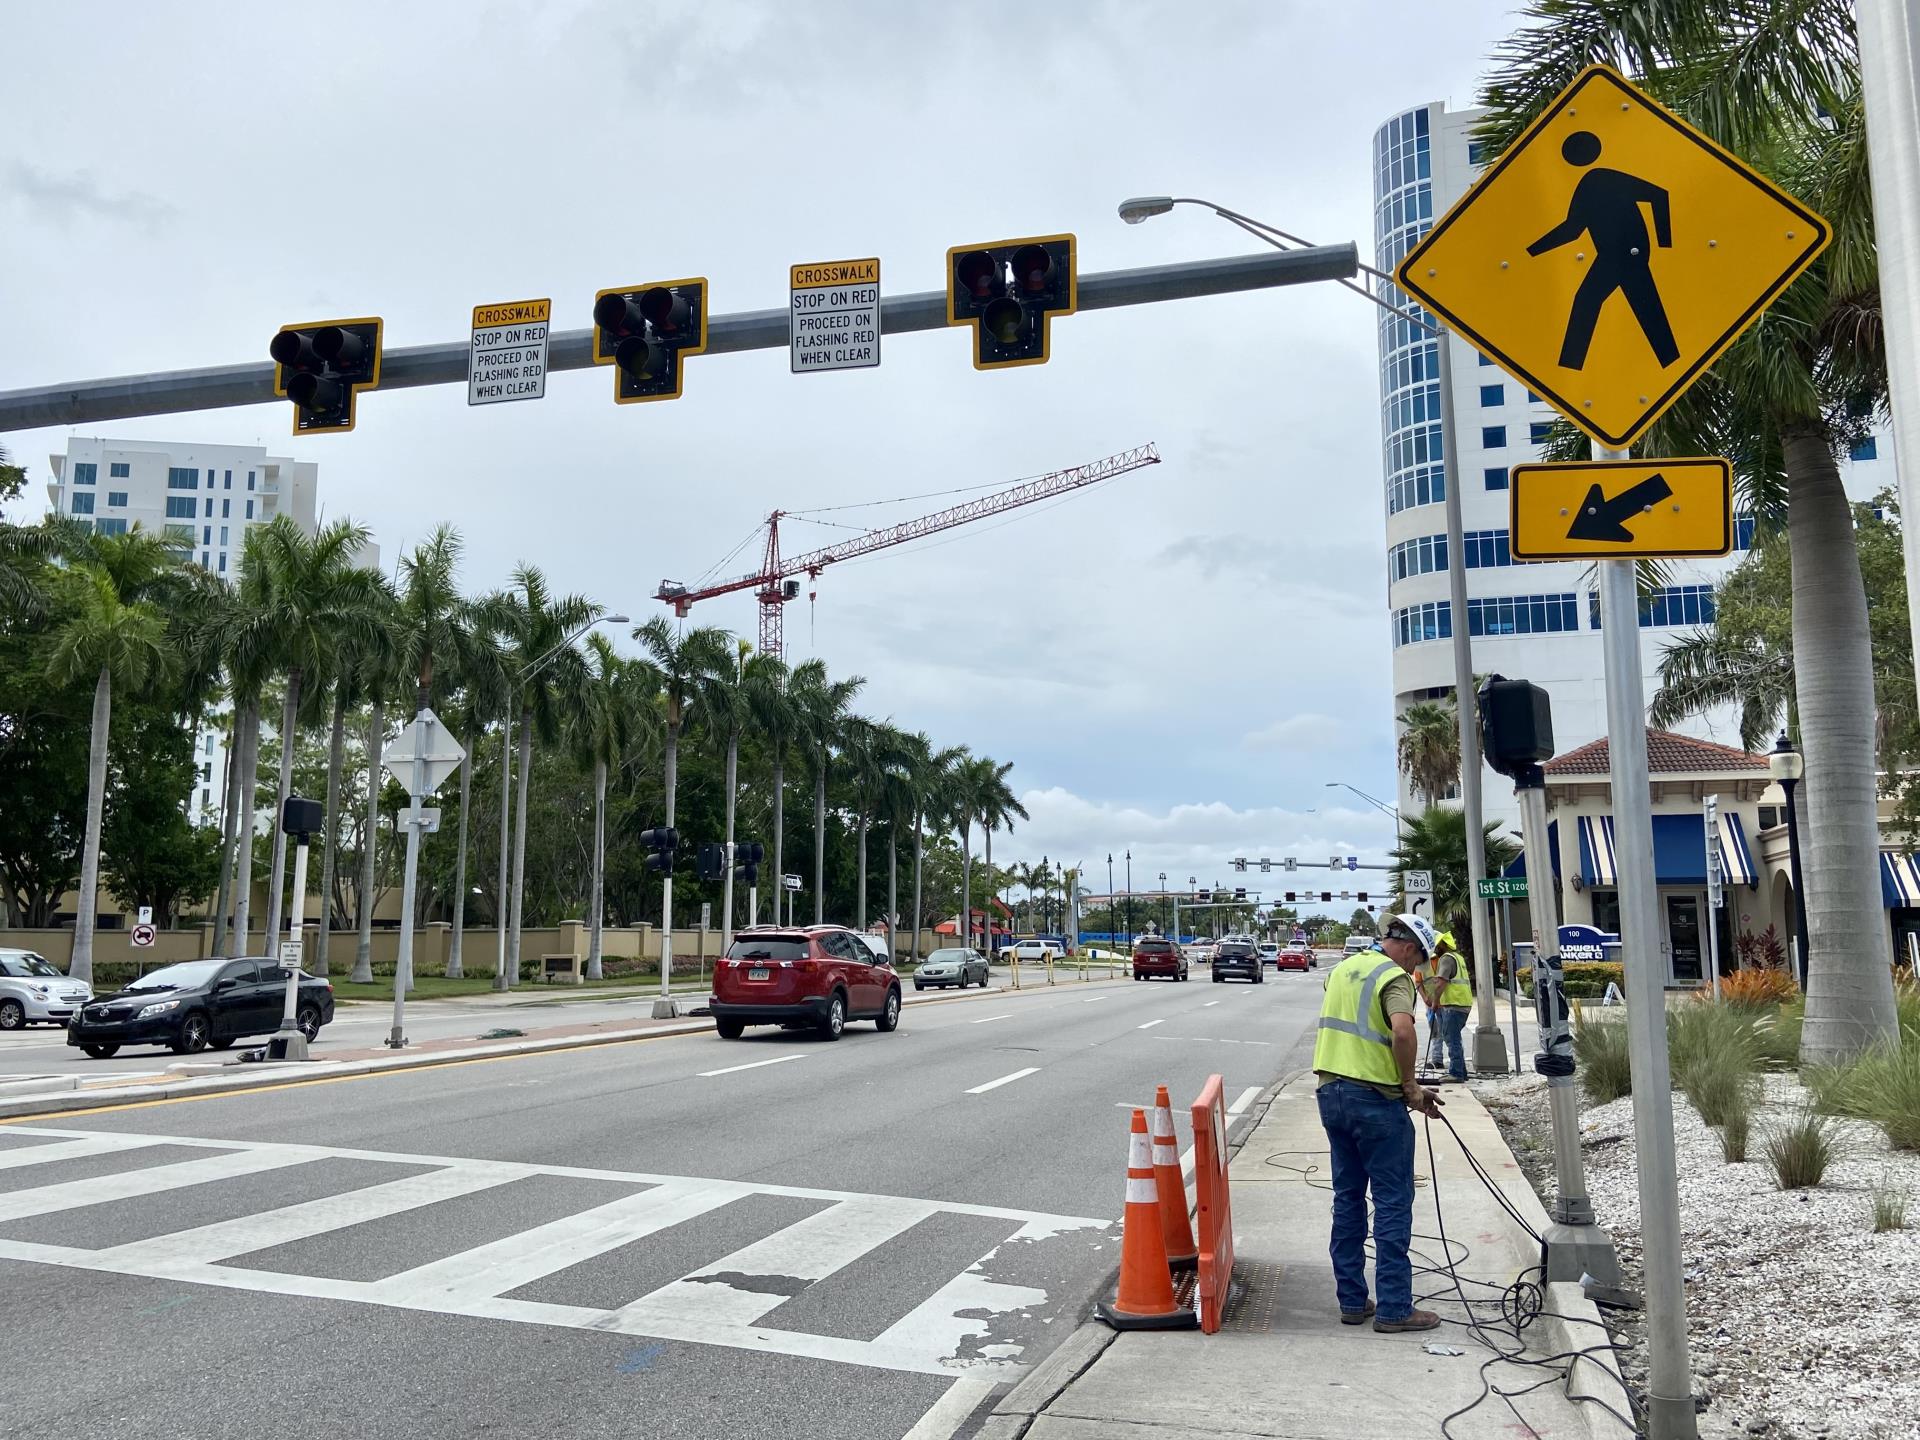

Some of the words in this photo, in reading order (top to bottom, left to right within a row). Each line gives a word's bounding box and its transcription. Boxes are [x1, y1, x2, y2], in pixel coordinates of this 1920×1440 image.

[796, 265, 873, 283] CROSSWALK
[794, 293, 826, 309] STOP
[830, 291, 848, 306] ON
[852, 289, 877, 304] RED
[477, 305, 545, 323] CROSSWALK
[800, 316, 850, 331] PROCEED
[855, 313, 871, 326] ON
[474, 332, 501, 346] STOP
[505, 330, 521, 344] ON
[524, 327, 546, 341] RED
[796, 333, 848, 348] FLASHING
[853, 330, 875, 344] RED
[478, 352, 521, 366] PROCEED
[525, 350, 540, 361] ON
[800, 350, 832, 365] WHEN
[835, 347, 871, 362] CLEAR
[473, 368, 519, 383] FLASHING
[522, 365, 541, 378] RED
[476, 385, 503, 399] WHEN
[506, 381, 537, 395] CLEAR
[1407, 879, 1426, 887] 780
[1479, 882, 1495, 894] 1st
[1497, 881, 1510, 893] St
[1560, 944, 1603, 952] LDWELL
